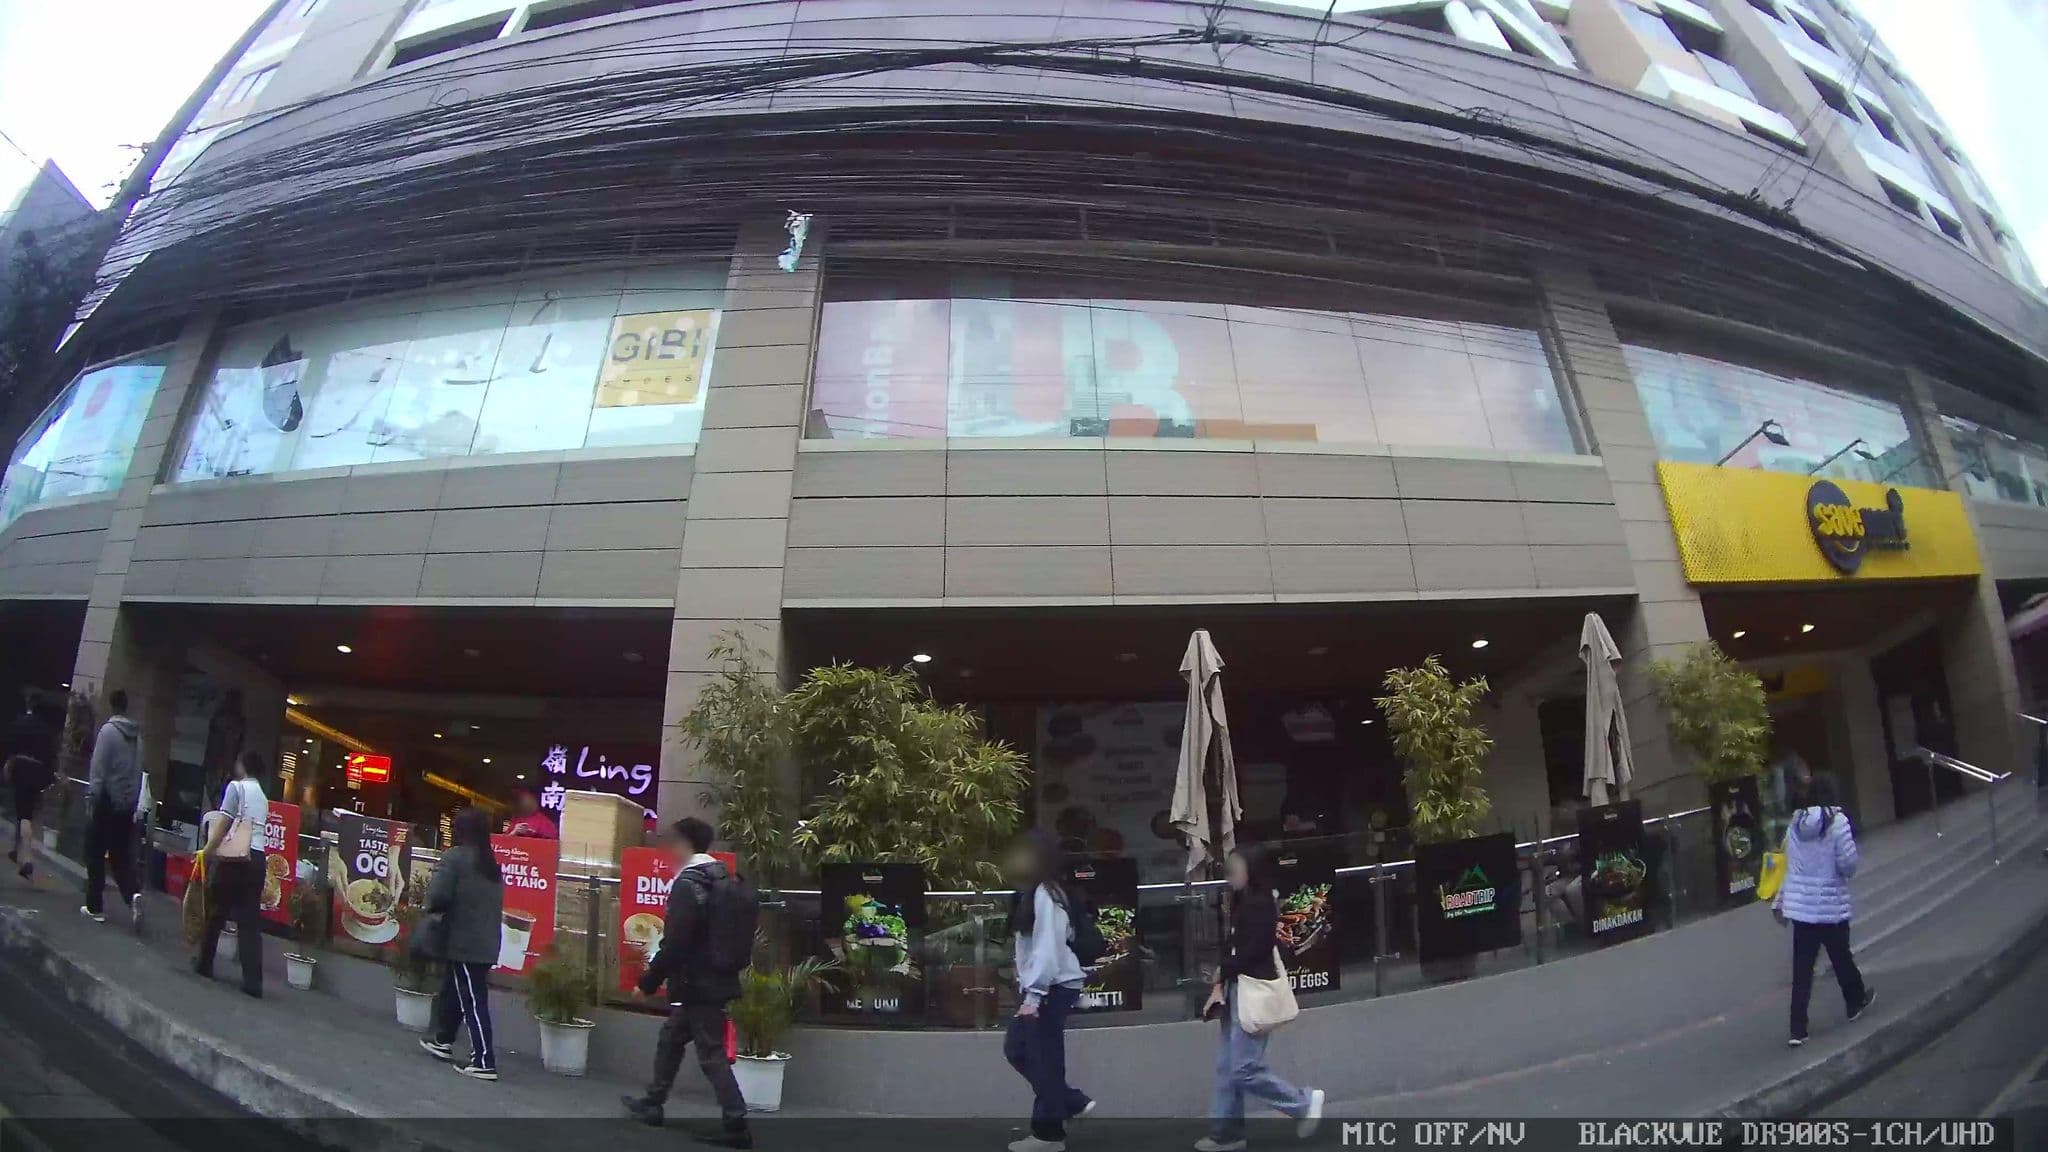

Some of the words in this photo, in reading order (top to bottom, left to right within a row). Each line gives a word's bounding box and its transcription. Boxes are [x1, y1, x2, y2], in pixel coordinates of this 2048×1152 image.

[612, 328, 703, 362] GIBI
[576, 746, 653, 795] Ling
[265, 822, 287, 839] ORT
[359, 838, 390, 852] TASTE
[356, 852, 389, 877] OG
[501, 862, 528, 877] MILK
[530, 865, 540, 877] &
[515, 876, 548, 890] TAHO
[1445, 887, 1496, 910] ROADTRIP
[1300, 971, 1329, 989] EGGS
